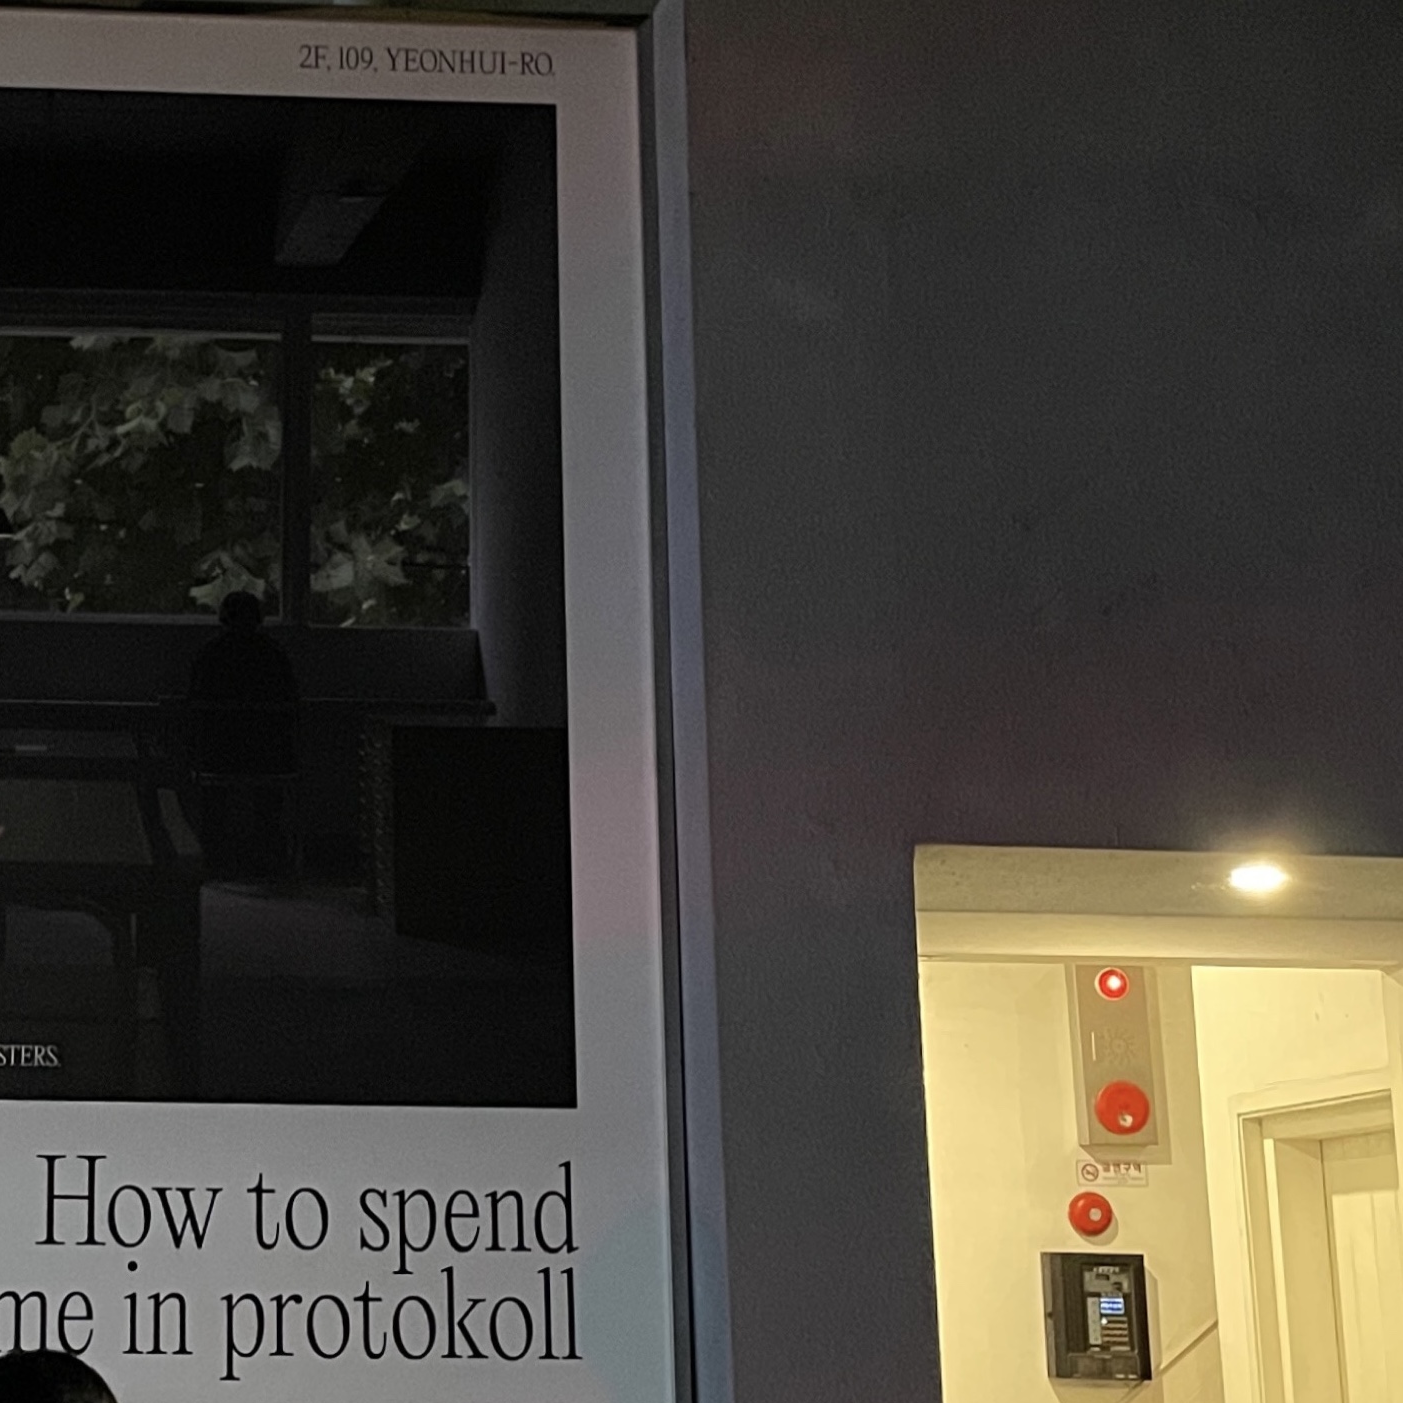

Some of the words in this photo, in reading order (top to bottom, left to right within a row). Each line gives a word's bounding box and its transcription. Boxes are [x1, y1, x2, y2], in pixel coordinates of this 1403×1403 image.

[35, 1154, 223, 1250] How
[246, 1172, 329, 1250] to
[359, 1160, 579, 1275] spend
[122, 1260, 194, 1355] in
[219, 1265, 584, 1381] protokoll
